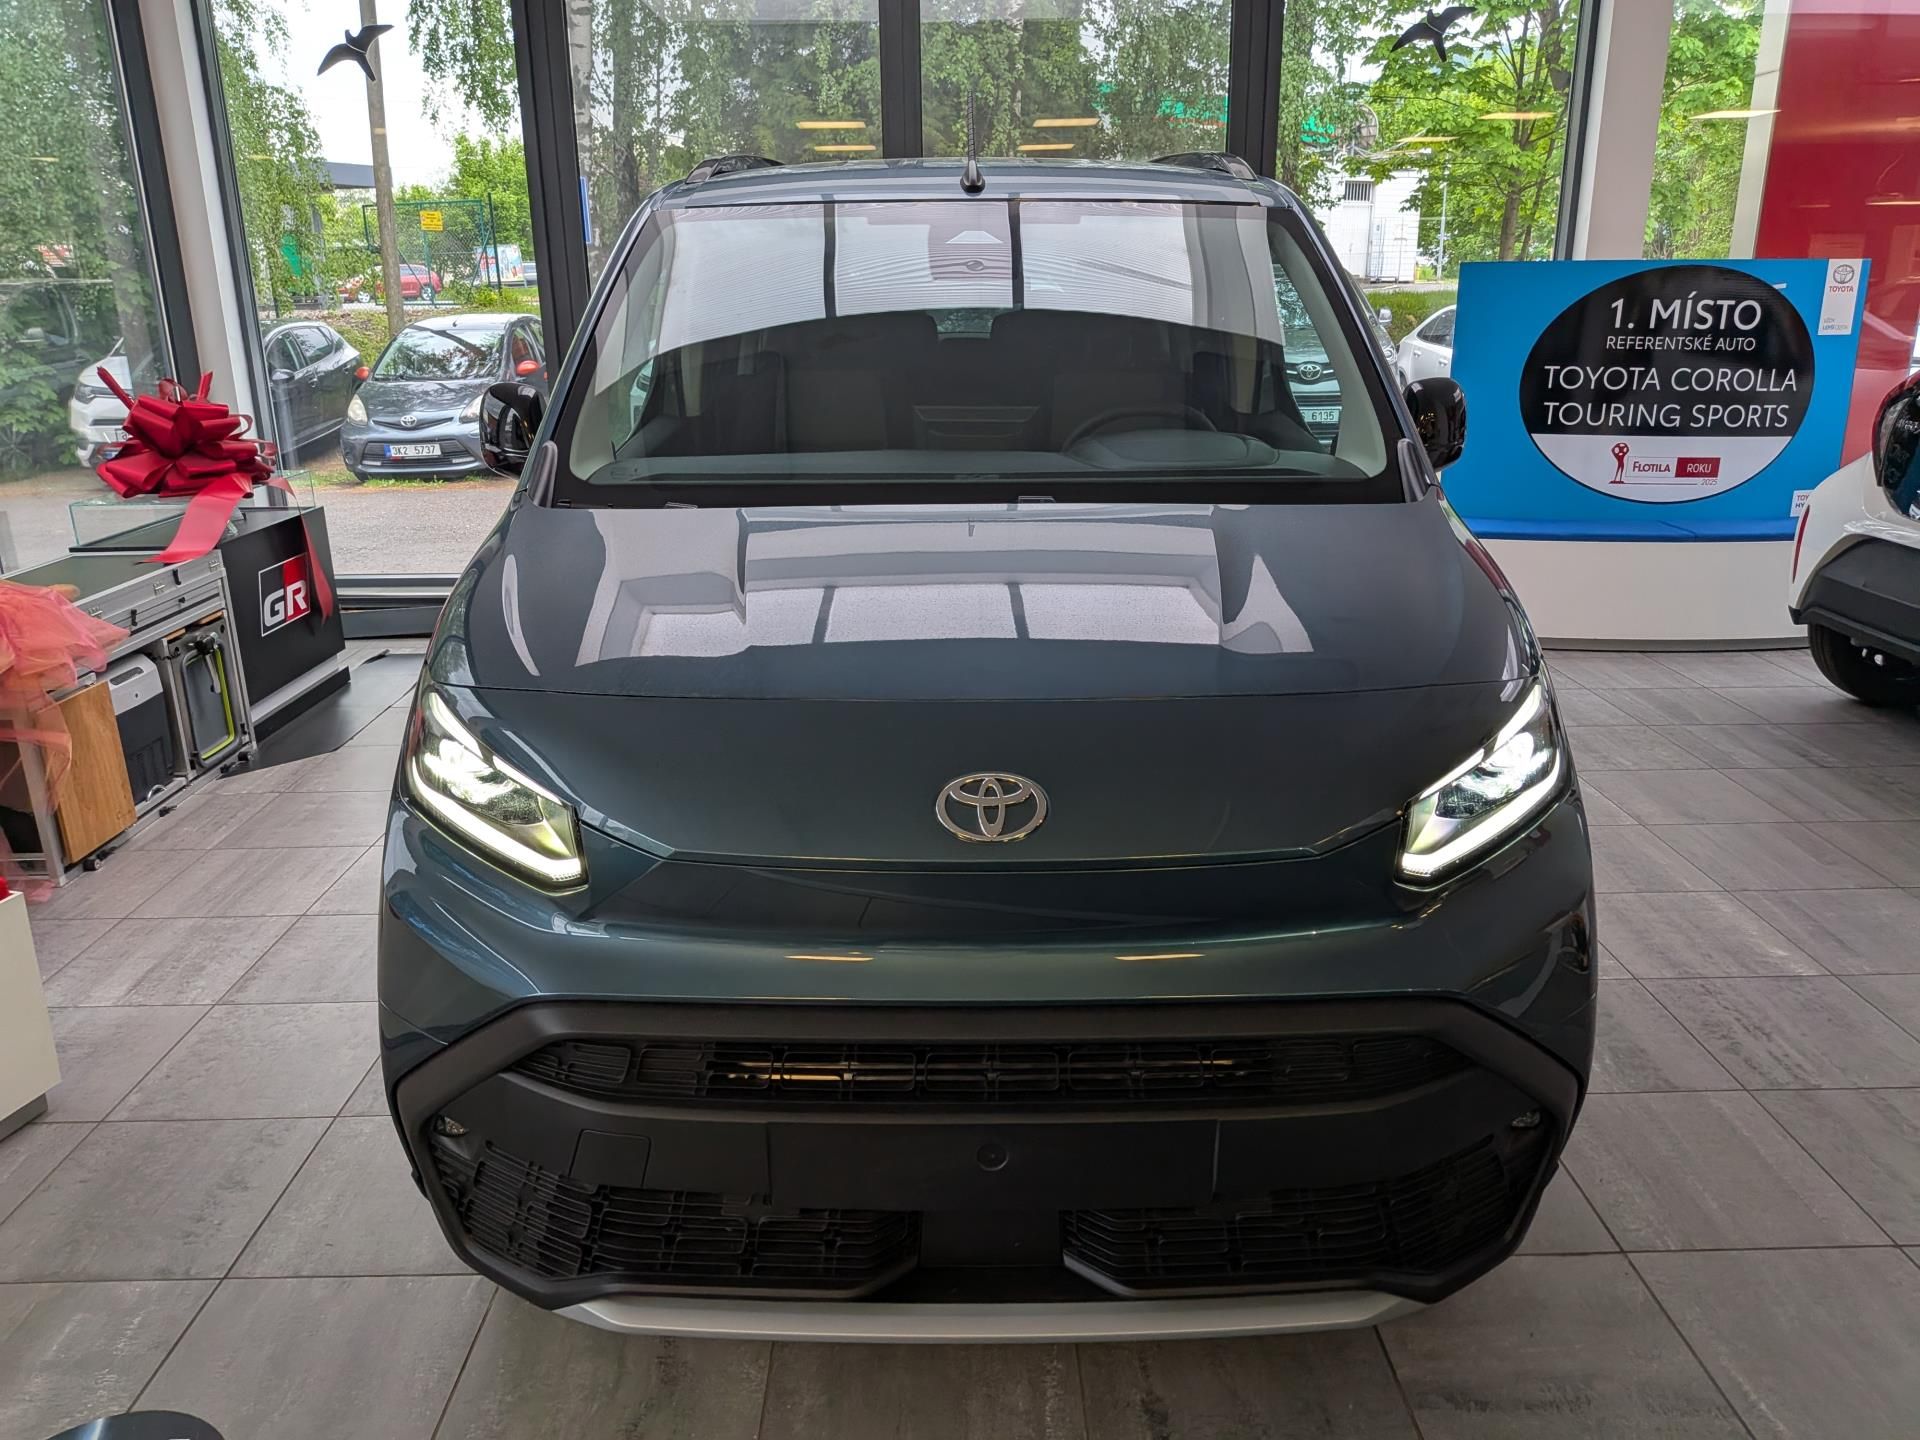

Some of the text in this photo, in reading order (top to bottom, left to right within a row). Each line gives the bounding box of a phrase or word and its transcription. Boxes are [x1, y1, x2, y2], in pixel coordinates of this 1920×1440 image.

[1611, 290, 1762, 331] 1. MÍSTO
[1606, 334, 1756, 351] REFERENTSKÉ AUTO
[1544, 365, 1797, 392] TOYOTA COROLLA
[1543, 402, 1790, 428] TOURING SPORTS
[392, 445, 436, 455] 3K2 5737
[1632, 461, 1712, 473] FLOTILA ROKU
[264, 580, 308, 627] GR
